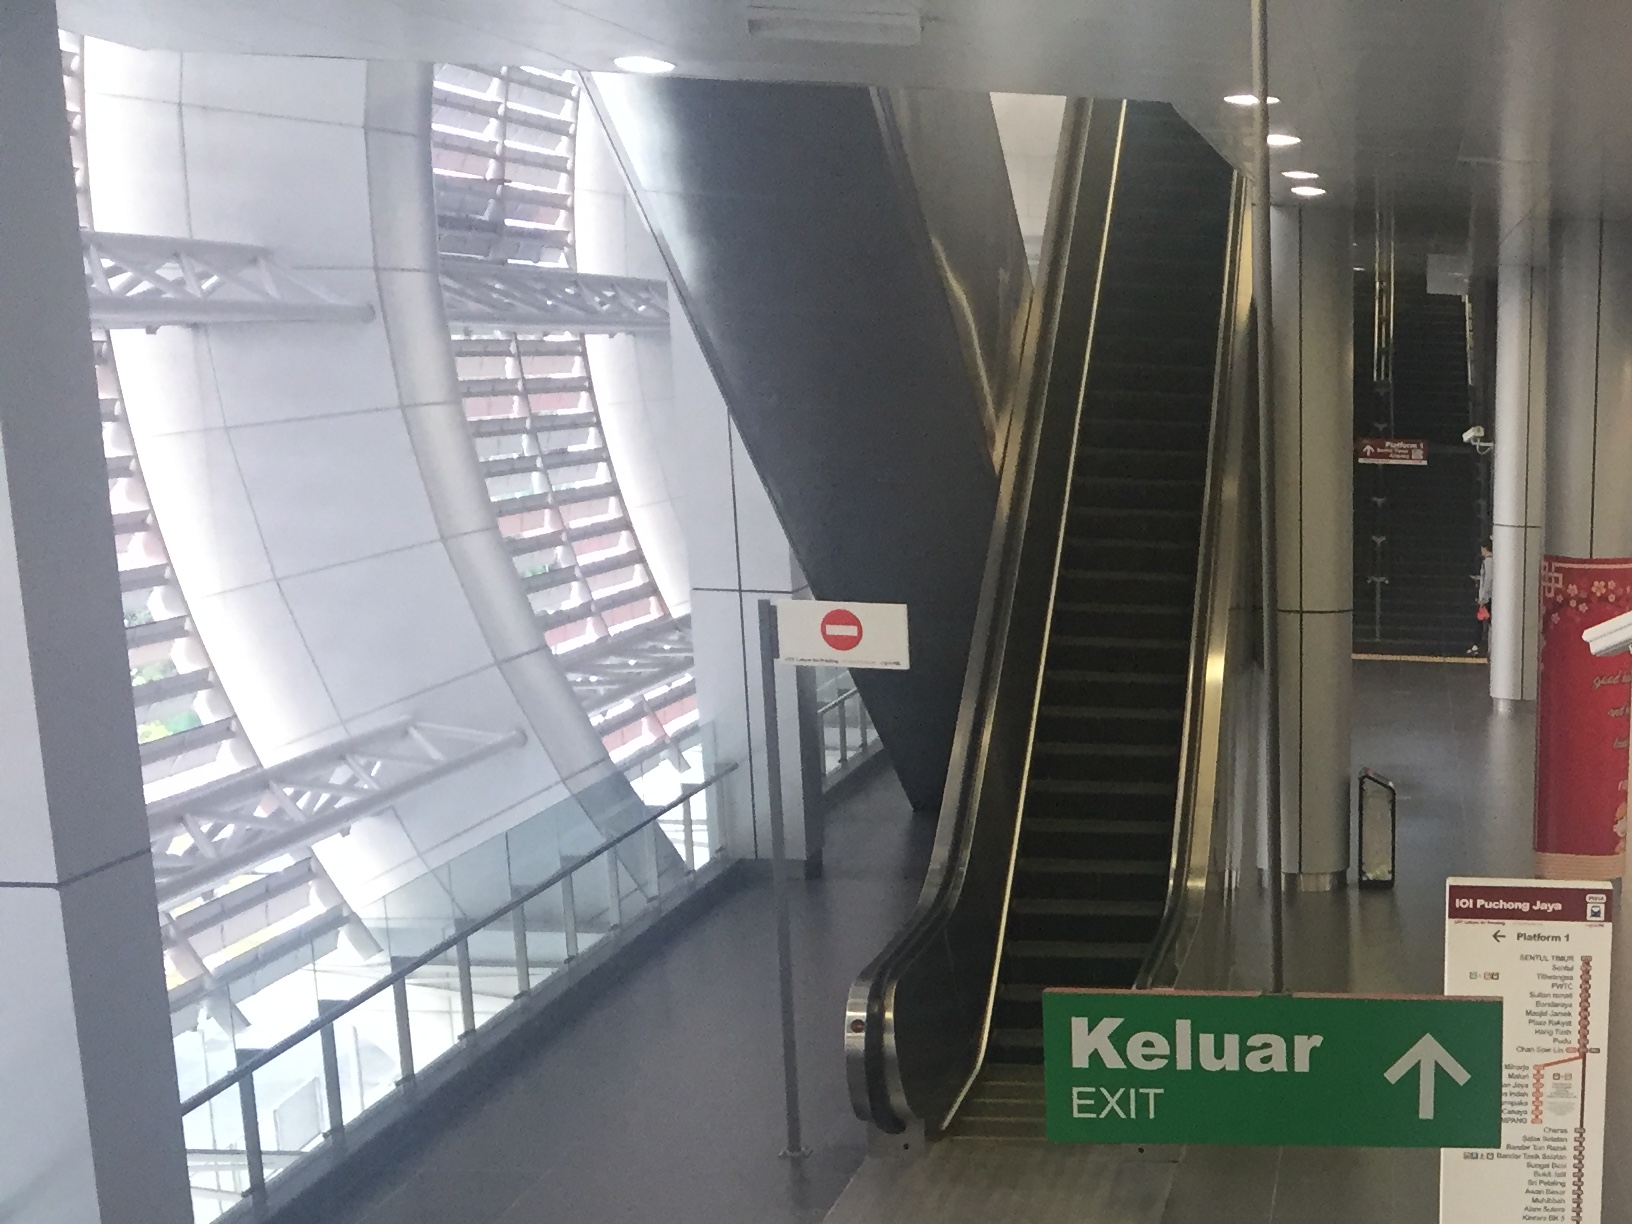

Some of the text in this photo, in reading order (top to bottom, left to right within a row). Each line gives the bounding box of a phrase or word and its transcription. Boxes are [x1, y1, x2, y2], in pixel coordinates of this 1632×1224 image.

[1455, 899, 1563, 913] IOI Puchong Jaya
[1516, 932, 1570, 942] Platform 1
[1520, 954, 1549, 962] SENTUL
[1070, 1016, 1324, 1073] Keluar
[1071, 1087, 1165, 1119] EXIT
